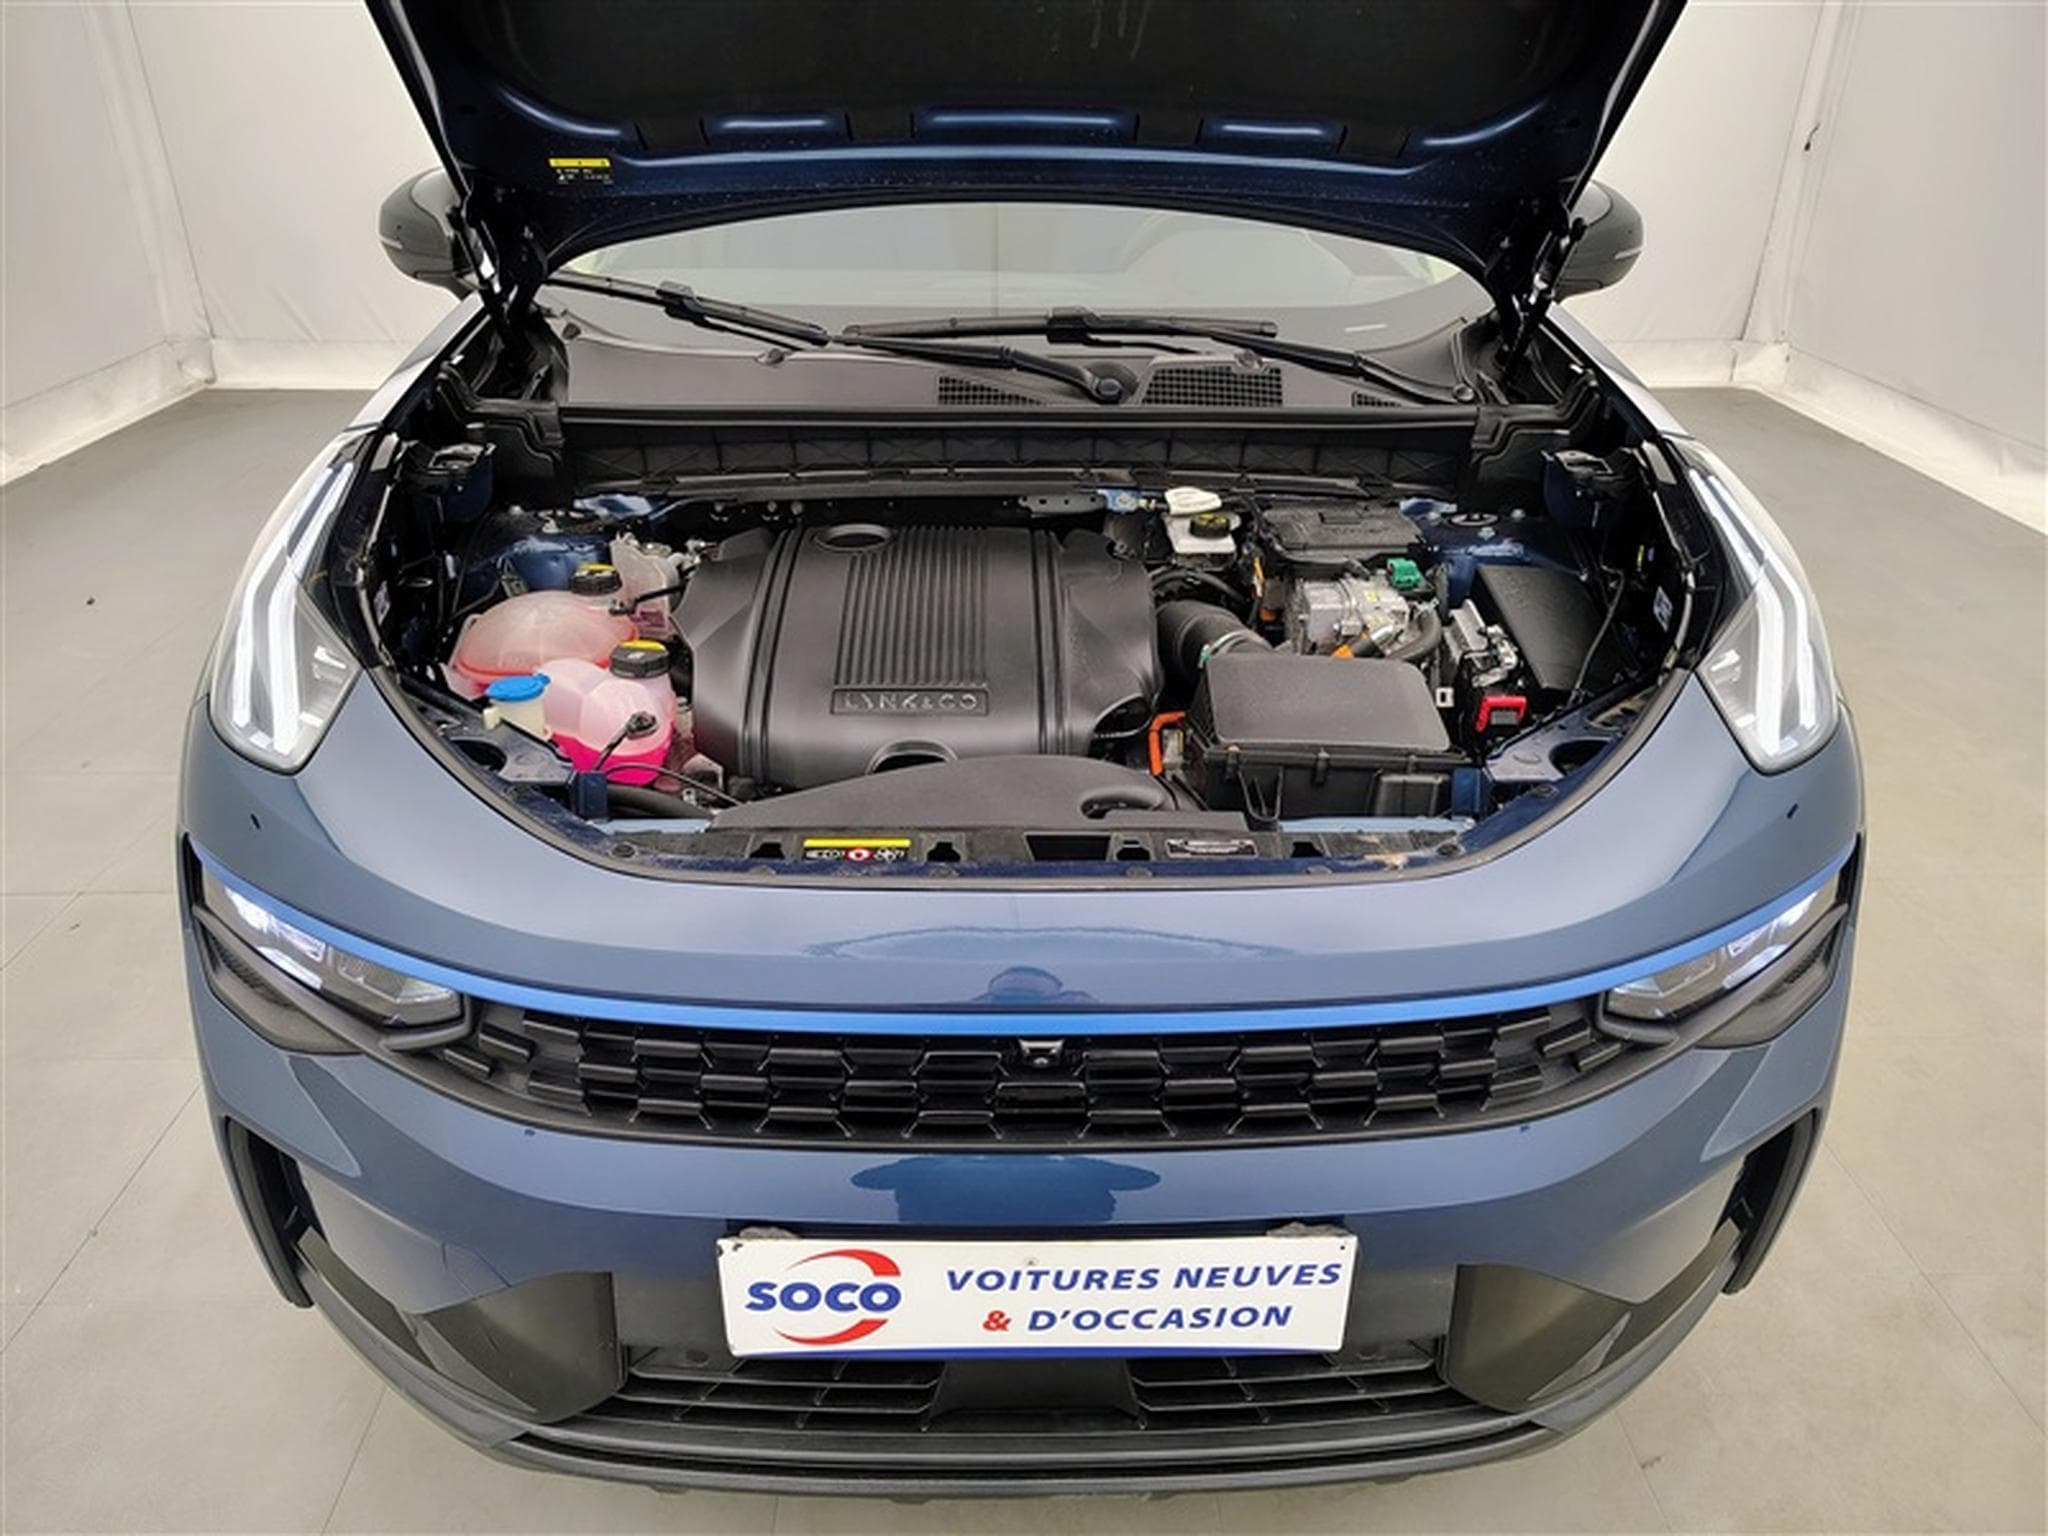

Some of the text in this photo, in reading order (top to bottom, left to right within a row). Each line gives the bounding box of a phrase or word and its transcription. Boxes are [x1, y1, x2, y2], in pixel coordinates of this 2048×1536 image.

[946, 1263, 1342, 1292] VOITURES NEUVES
[745, 1281, 902, 1313] SOCO
[982, 1305, 1293, 1332] & D'OCCASION
